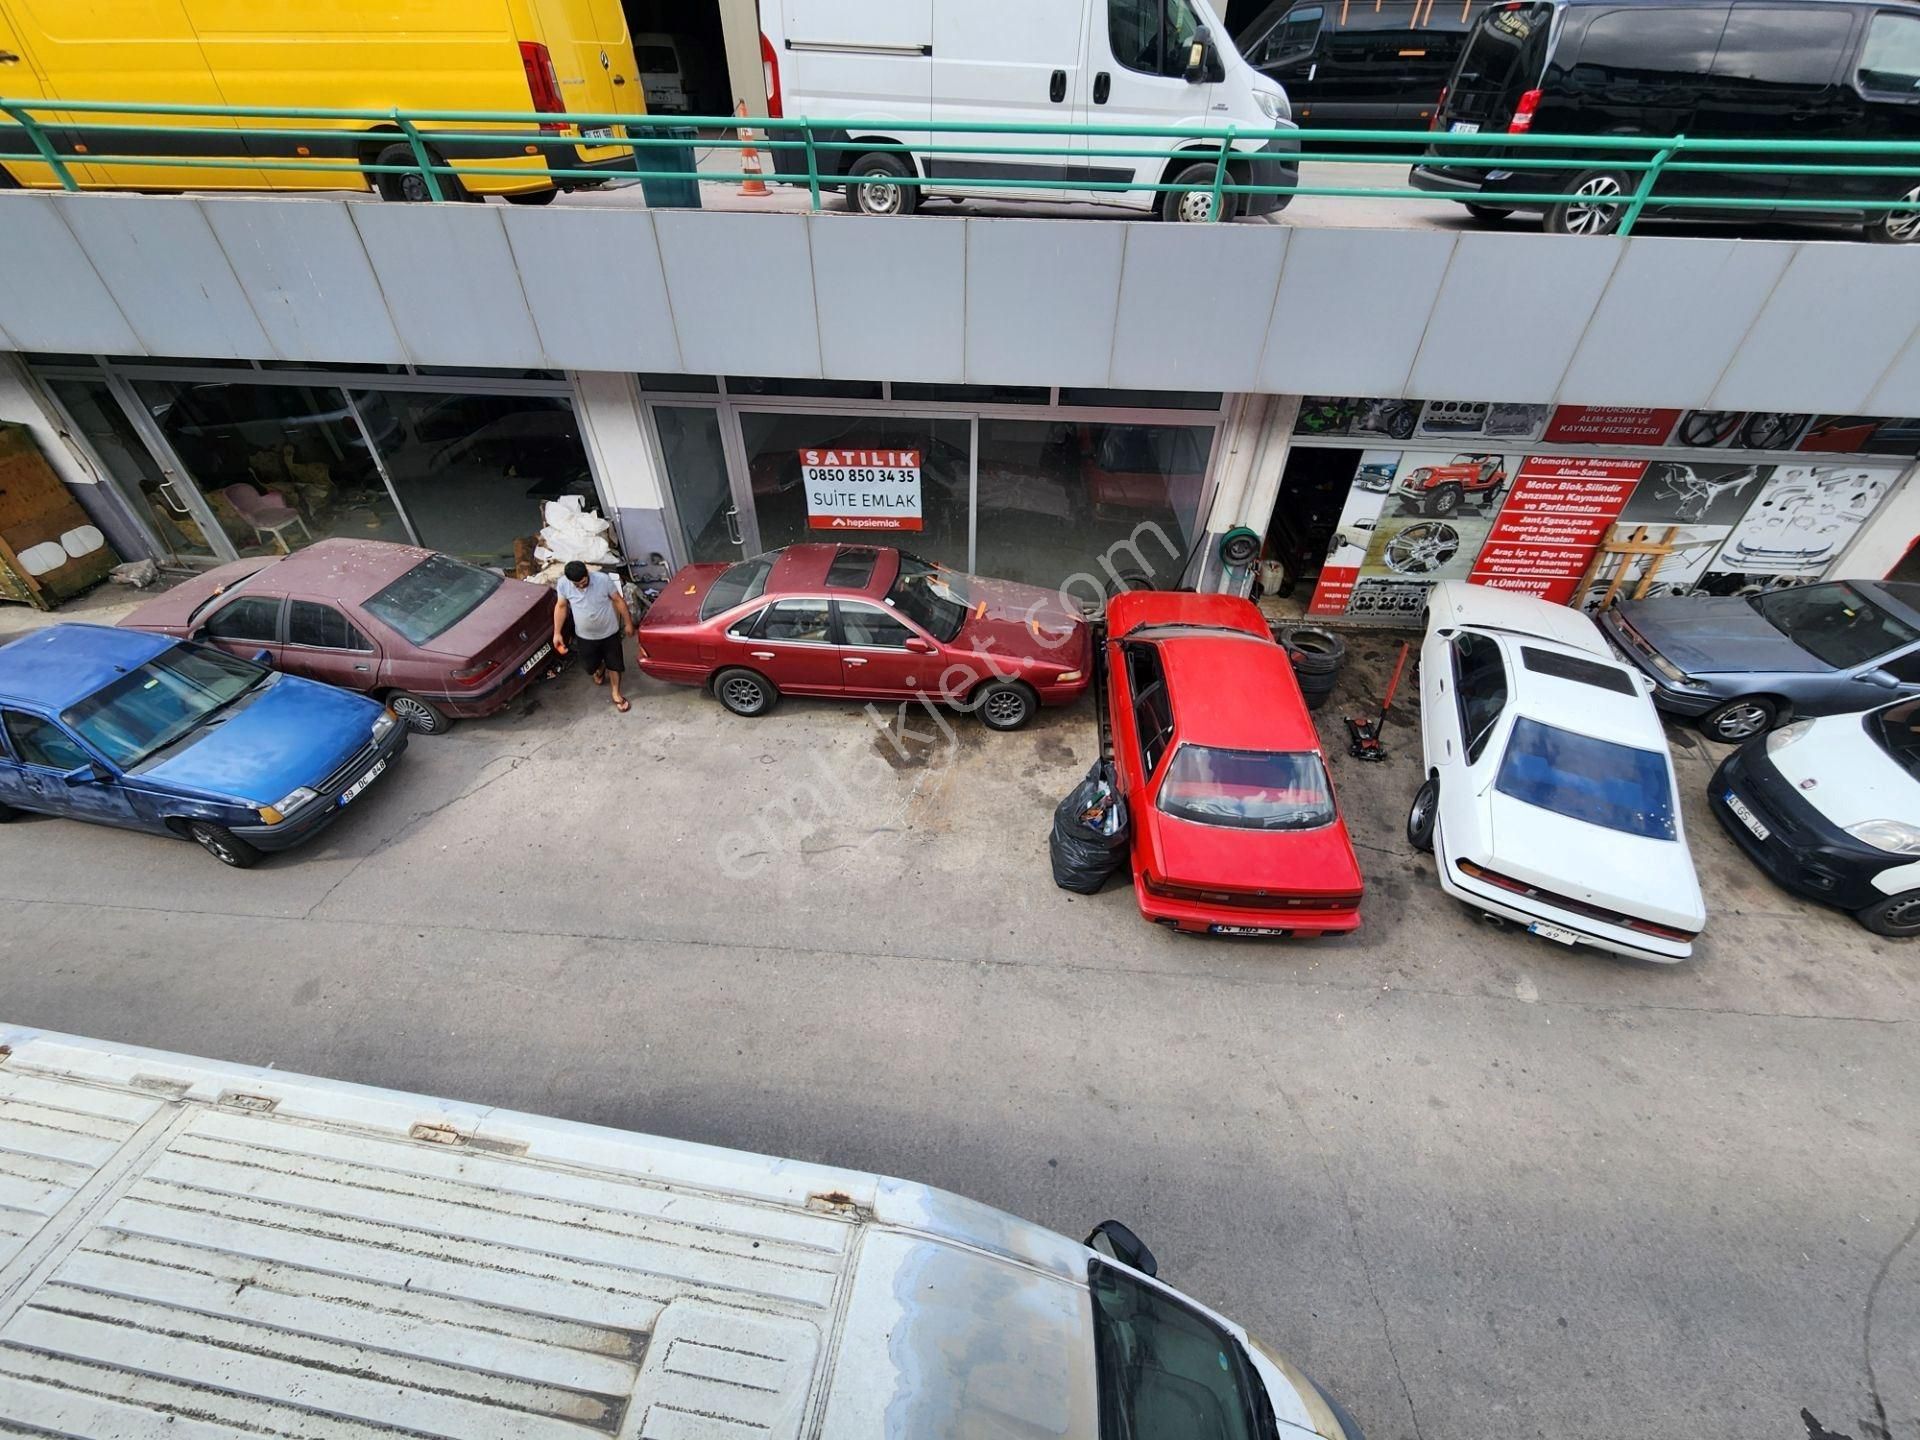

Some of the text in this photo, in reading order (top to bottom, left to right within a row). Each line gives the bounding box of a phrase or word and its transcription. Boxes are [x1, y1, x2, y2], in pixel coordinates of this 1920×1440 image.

[1638, 417, 1651, 425] VE
[1559, 424, 1600, 433] KAYNAK
[805, 450, 915, 467] SATILIK
[1530, 456, 1574, 466] Otomotiv
[1588, 459, 1643, 469] Motorsiklet
[808, 468, 915, 483] 0850 850 34 35
[1556, 468, 1608, 477] Alım-Satım
[1525, 480, 1557, 490] Motor
[813, 489, 916, 508] SUİTE EMLAK
[1514, 491, 1623, 504] Şanzıman Kaynakları
[1538, 502, 1602, 513] Parlatmaları
[846, 518, 900, 529] hepsiemlak
[1500, 524, 1539, 534] Kaporta
[1539, 526, 1587, 536] kaynakları
[1519, 534, 1575, 544] Parlatmaları
[1492, 548, 1513, 557] Araç
[1558, 551, 1584, 559] Krom
[1491, 565, 1570, 576] Krom parlatmaları
